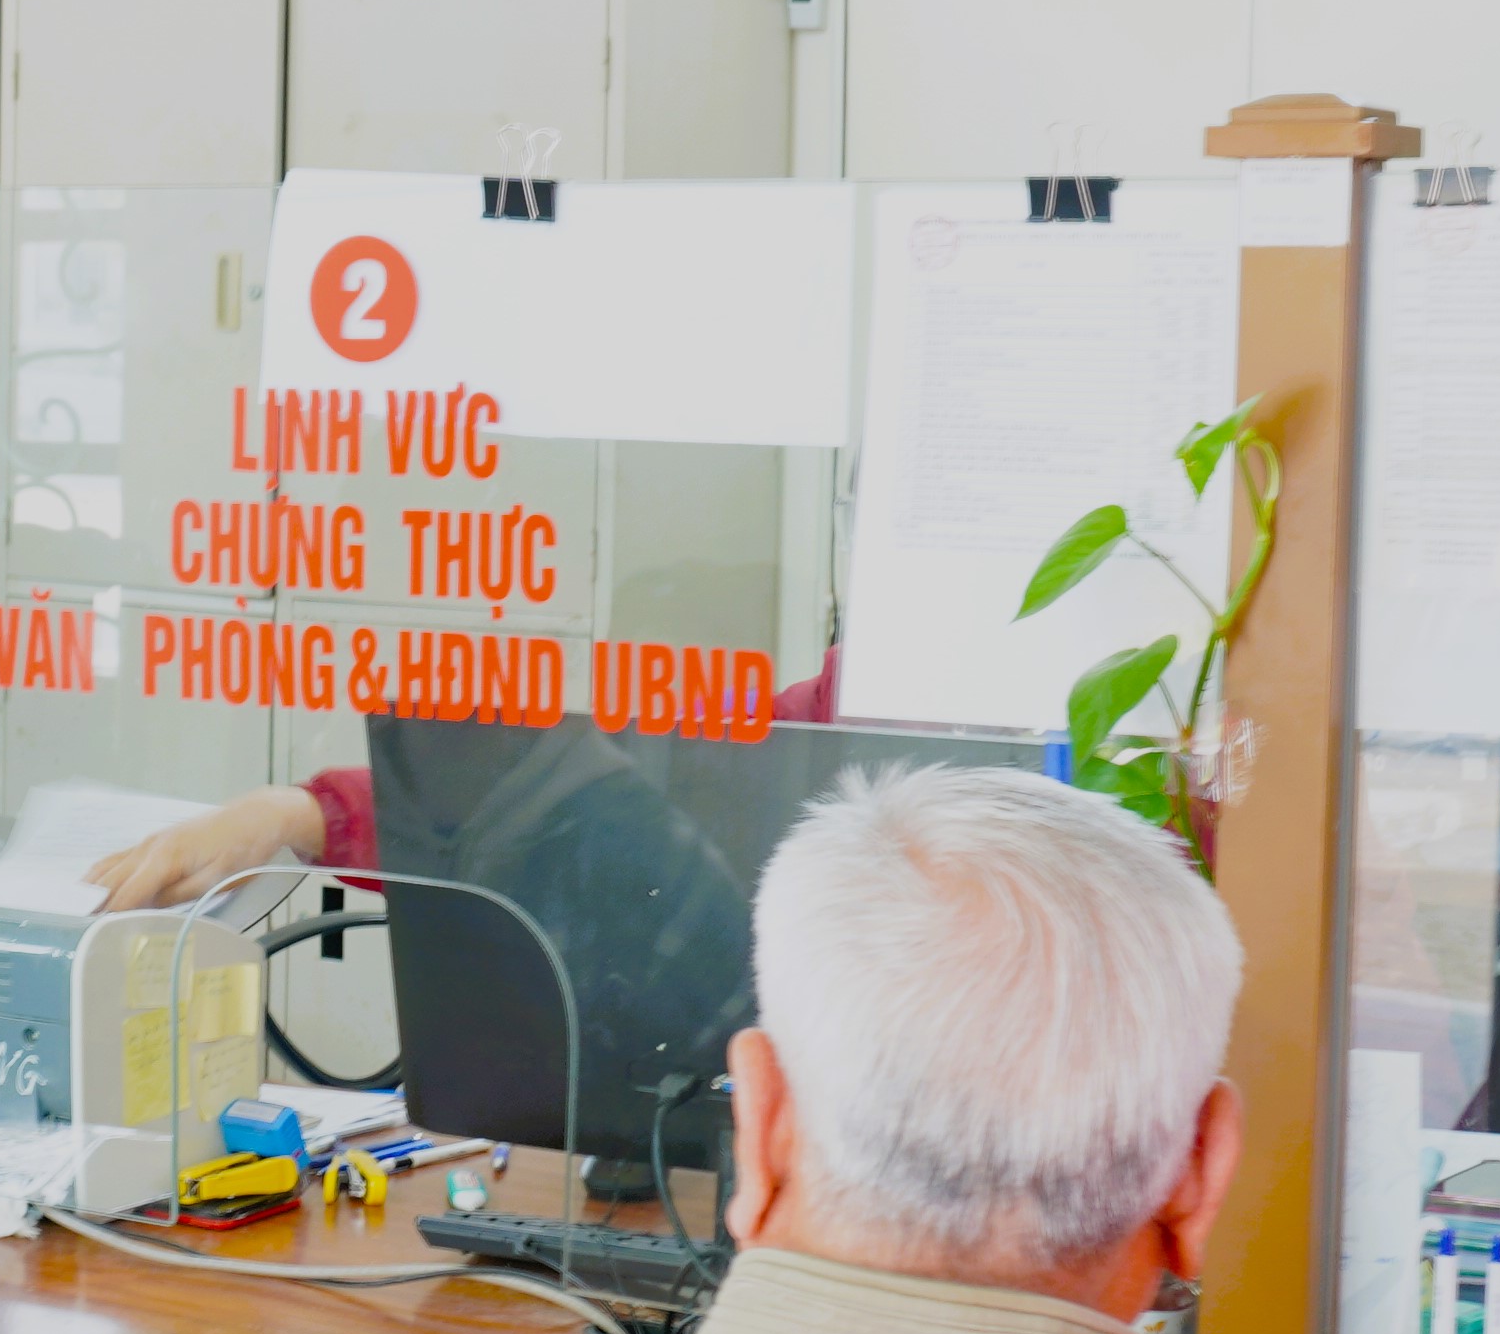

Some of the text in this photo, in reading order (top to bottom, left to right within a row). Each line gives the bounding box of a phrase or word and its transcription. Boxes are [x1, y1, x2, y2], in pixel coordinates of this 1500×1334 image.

[338, 257, 389, 343] 2
[170, 479, 557, 619] CHỨNG THỰC
[593, 640, 776, 745] UBND
